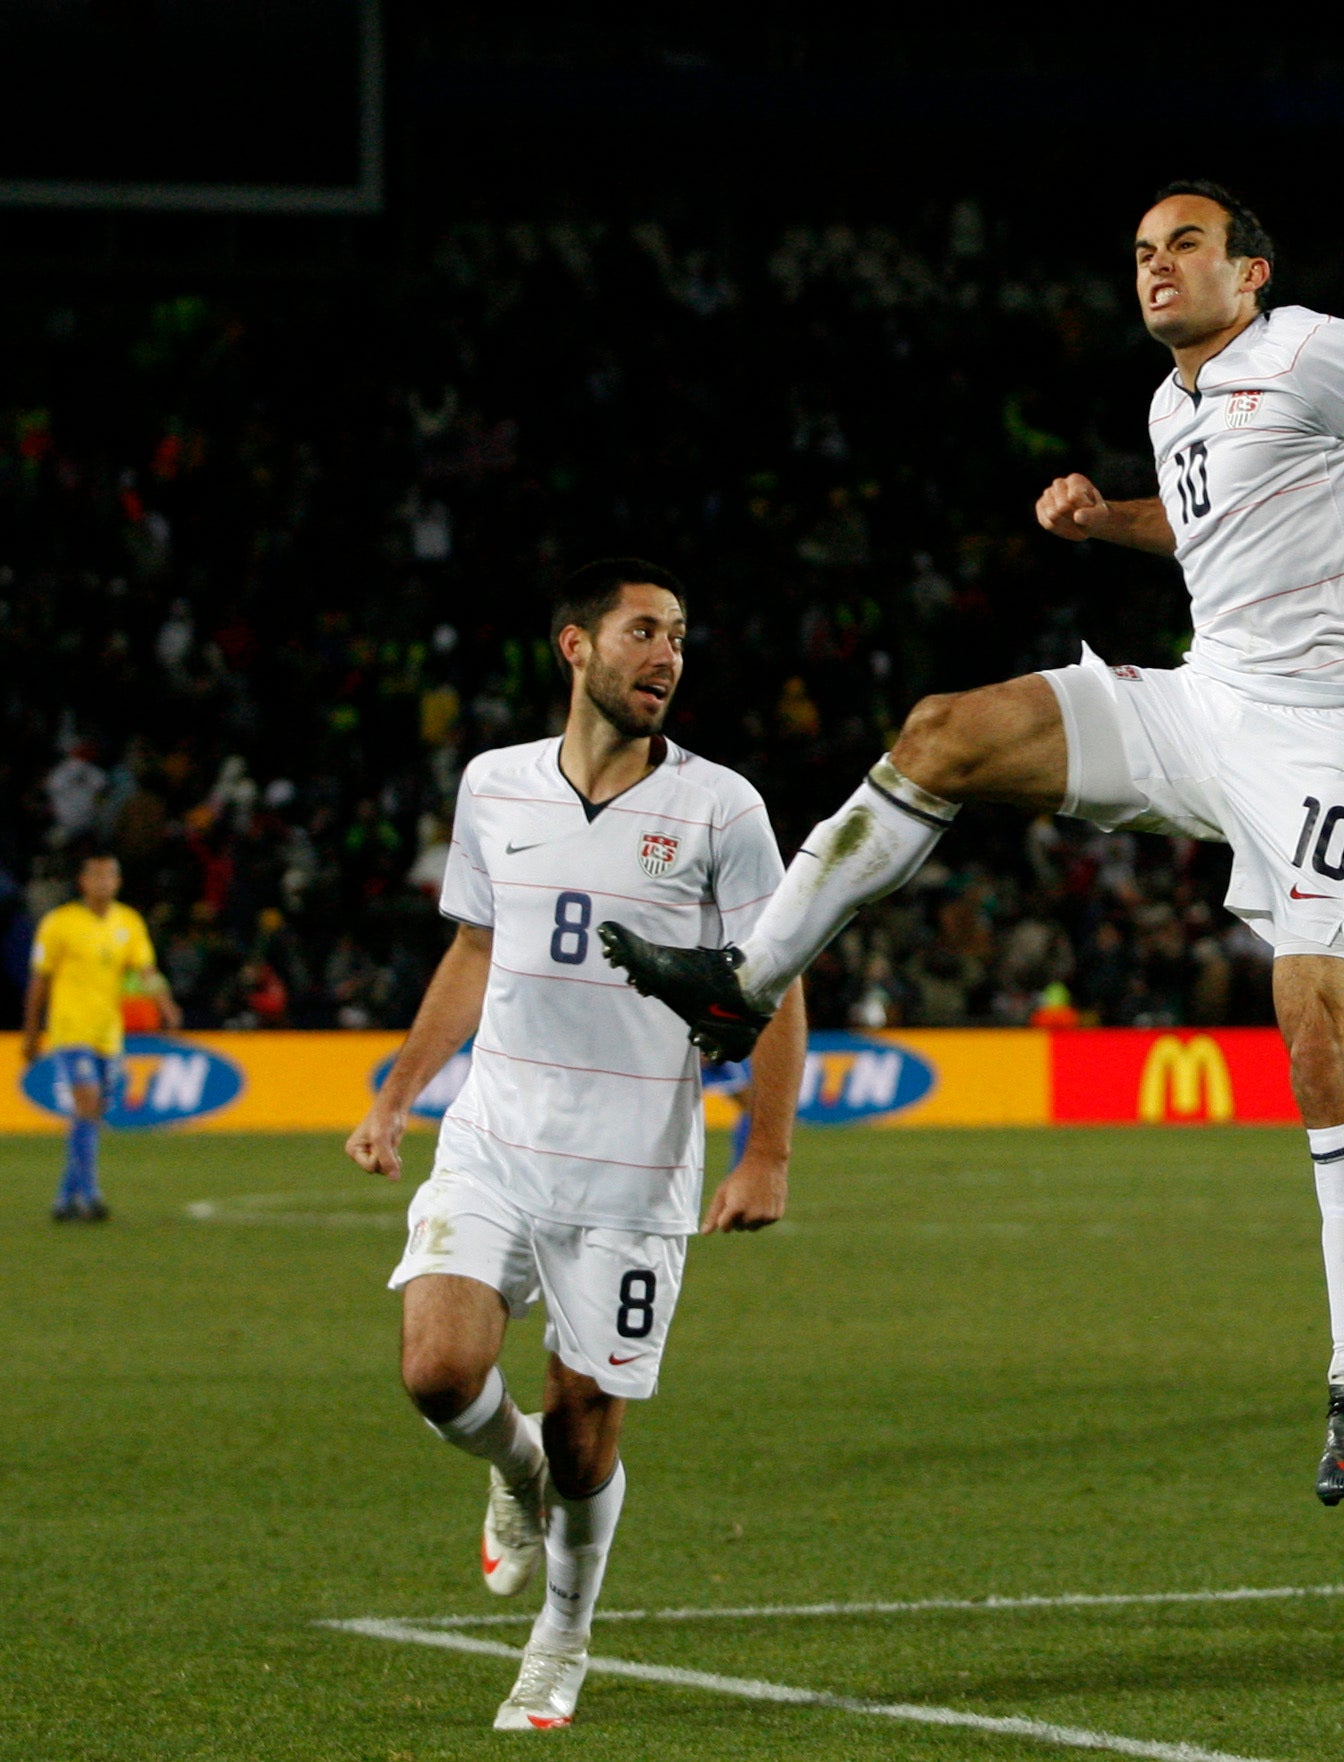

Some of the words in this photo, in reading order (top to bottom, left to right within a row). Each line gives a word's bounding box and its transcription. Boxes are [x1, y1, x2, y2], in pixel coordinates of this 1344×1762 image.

[1175, 441, 1211, 524] 10
[550, 891, 592, 965] 8
[617, 1269, 657, 1338] 8
